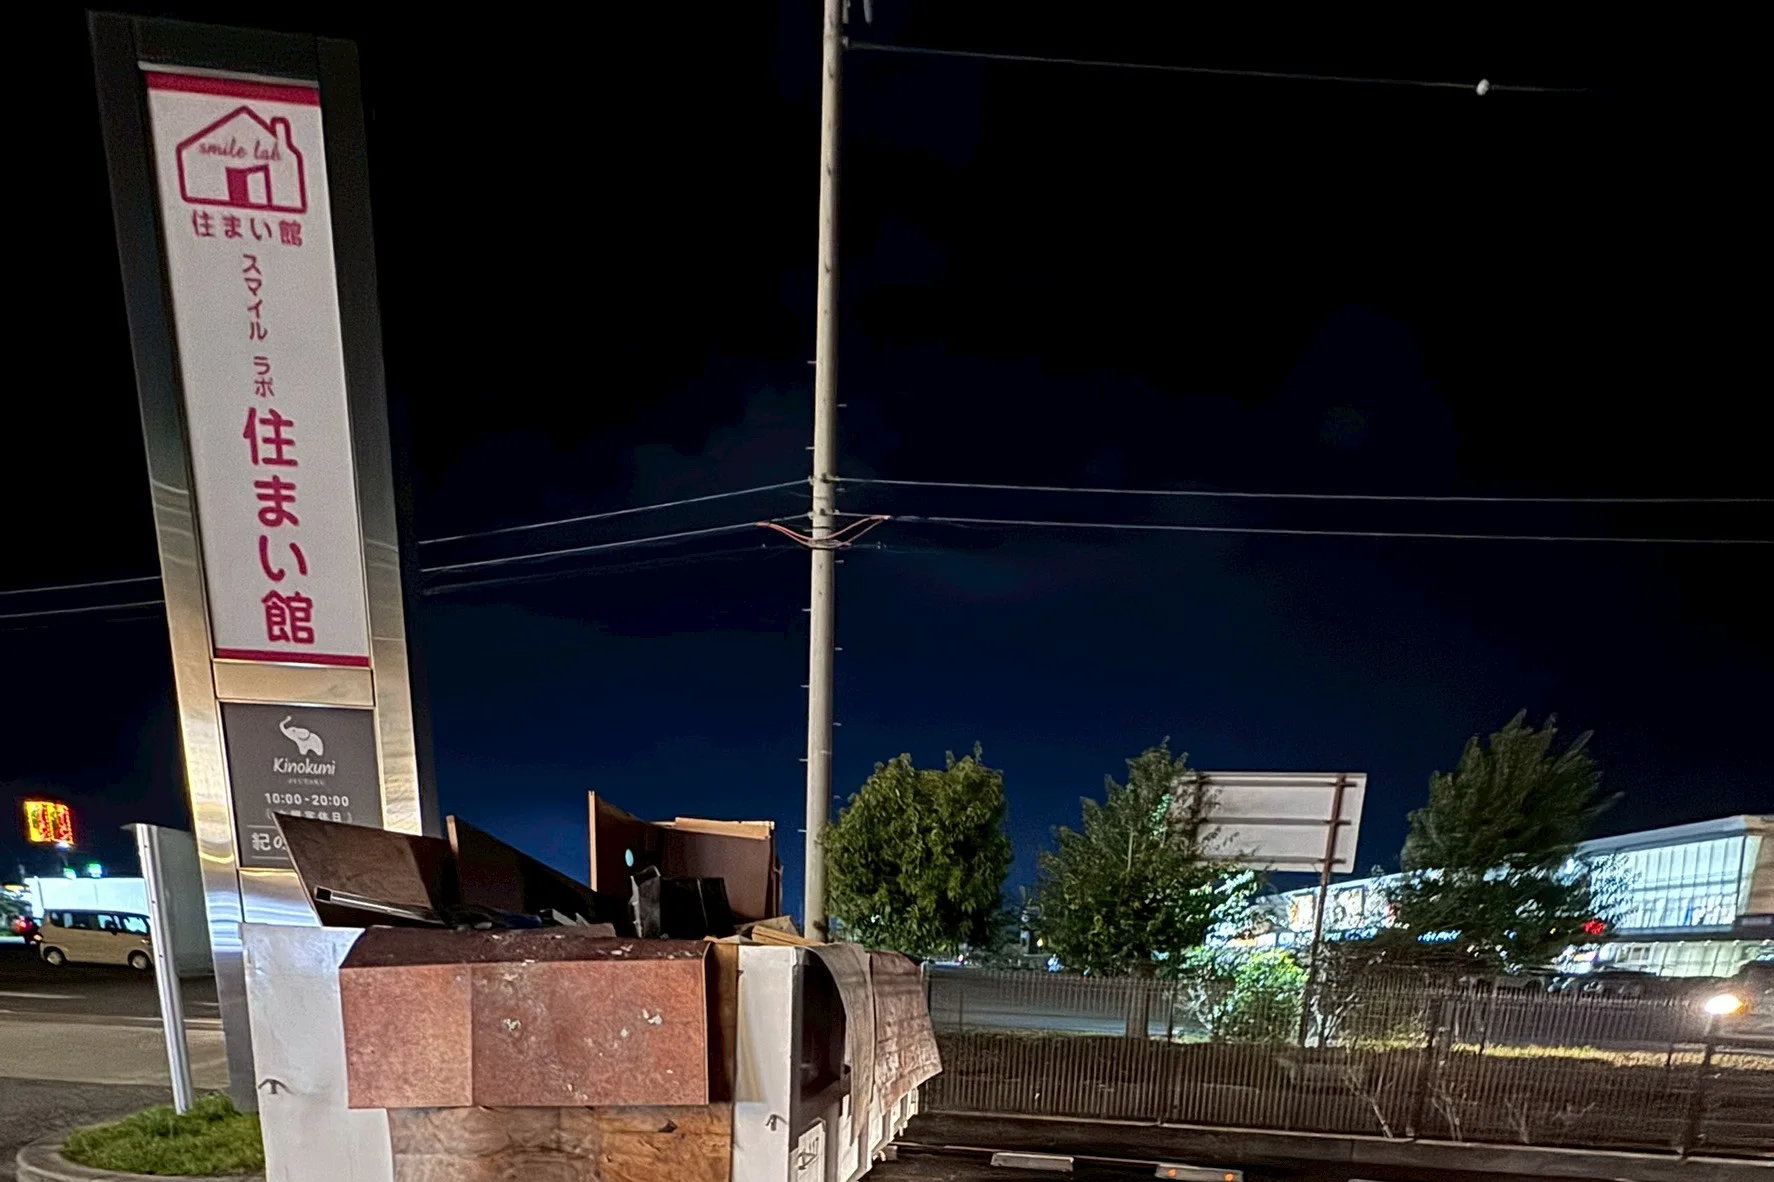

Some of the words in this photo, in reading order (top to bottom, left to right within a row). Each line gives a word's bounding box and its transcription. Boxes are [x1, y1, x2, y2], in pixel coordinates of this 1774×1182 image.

[199, 136, 247, 159] smile
[191, 209, 303, 247] 住まい館
[242, 253, 268, 341] スマイル
[242, 407, 315, 645] 住まい館
[273, 757, 336, 775] Kinokuni
